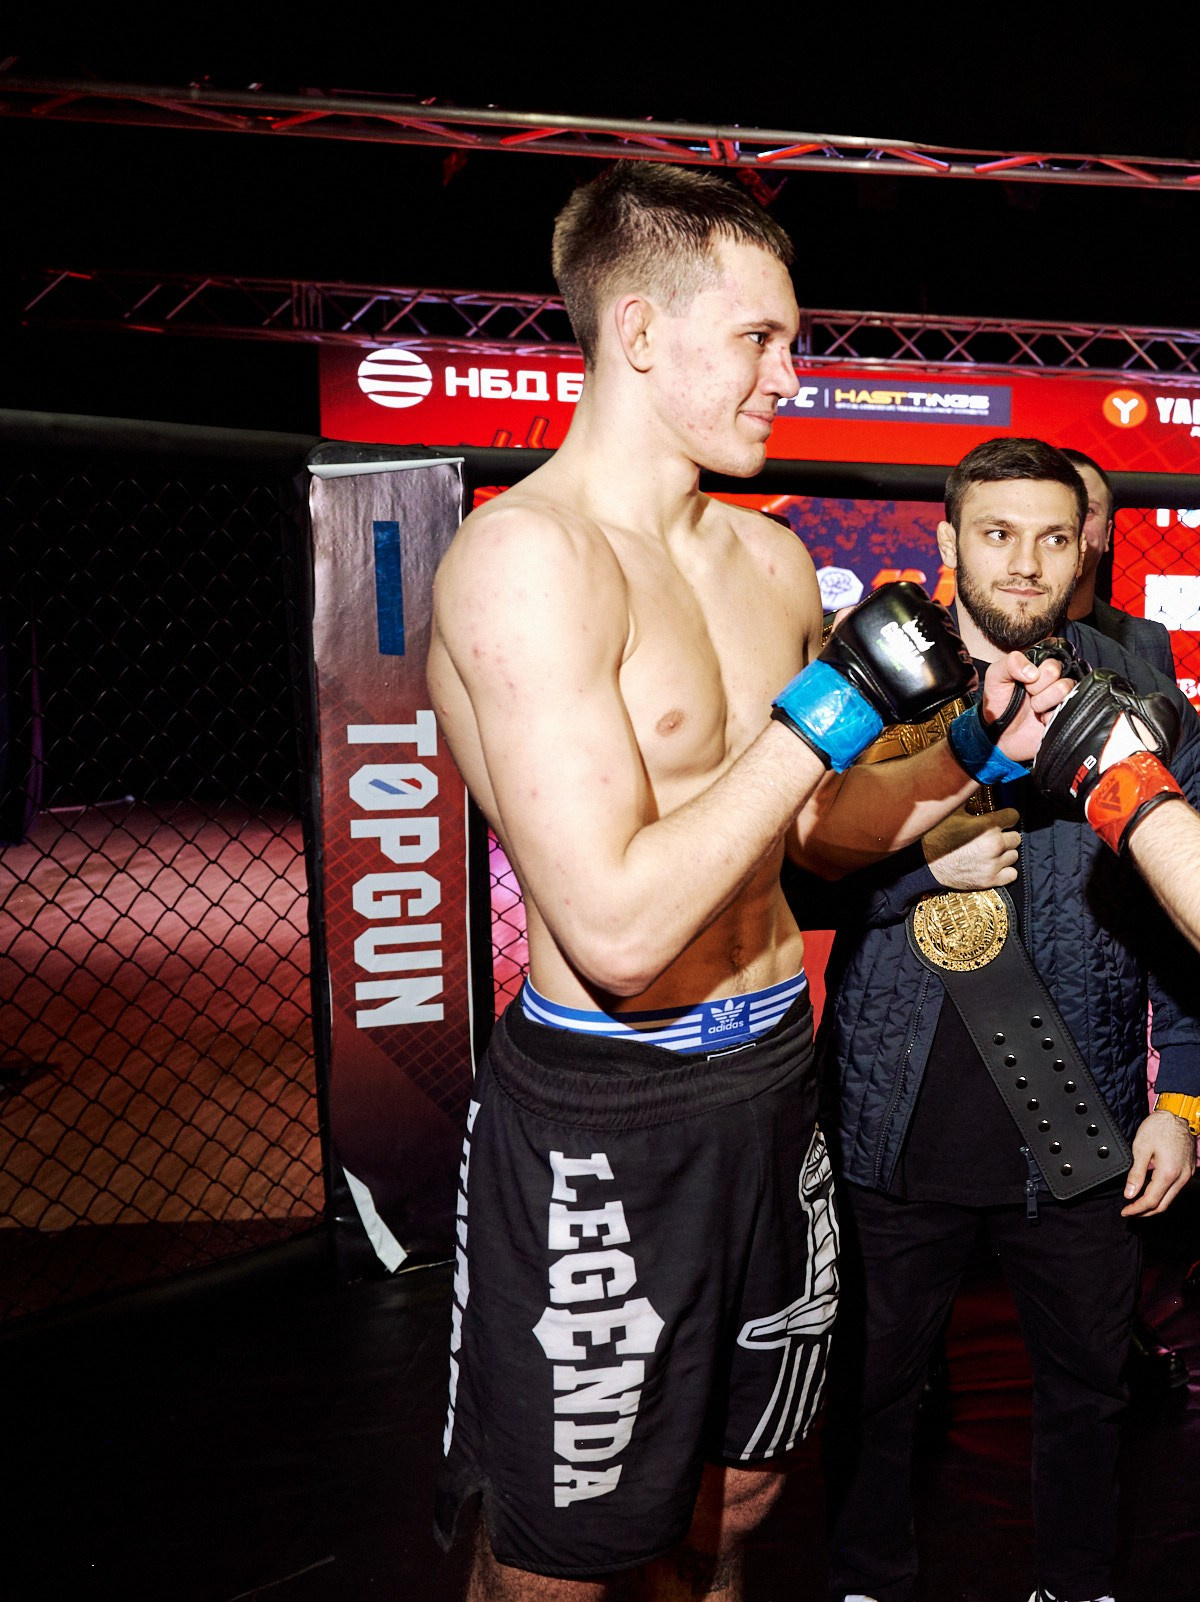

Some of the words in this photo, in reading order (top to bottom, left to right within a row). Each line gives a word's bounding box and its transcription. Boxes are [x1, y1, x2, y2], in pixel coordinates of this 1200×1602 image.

[445, 366, 550, 401] НБД
[346, 709, 445, 1029] TOPGUN
[707, 1018, 744, 1035] adidas
[531, 1150, 666, 1508] LEGENDA
